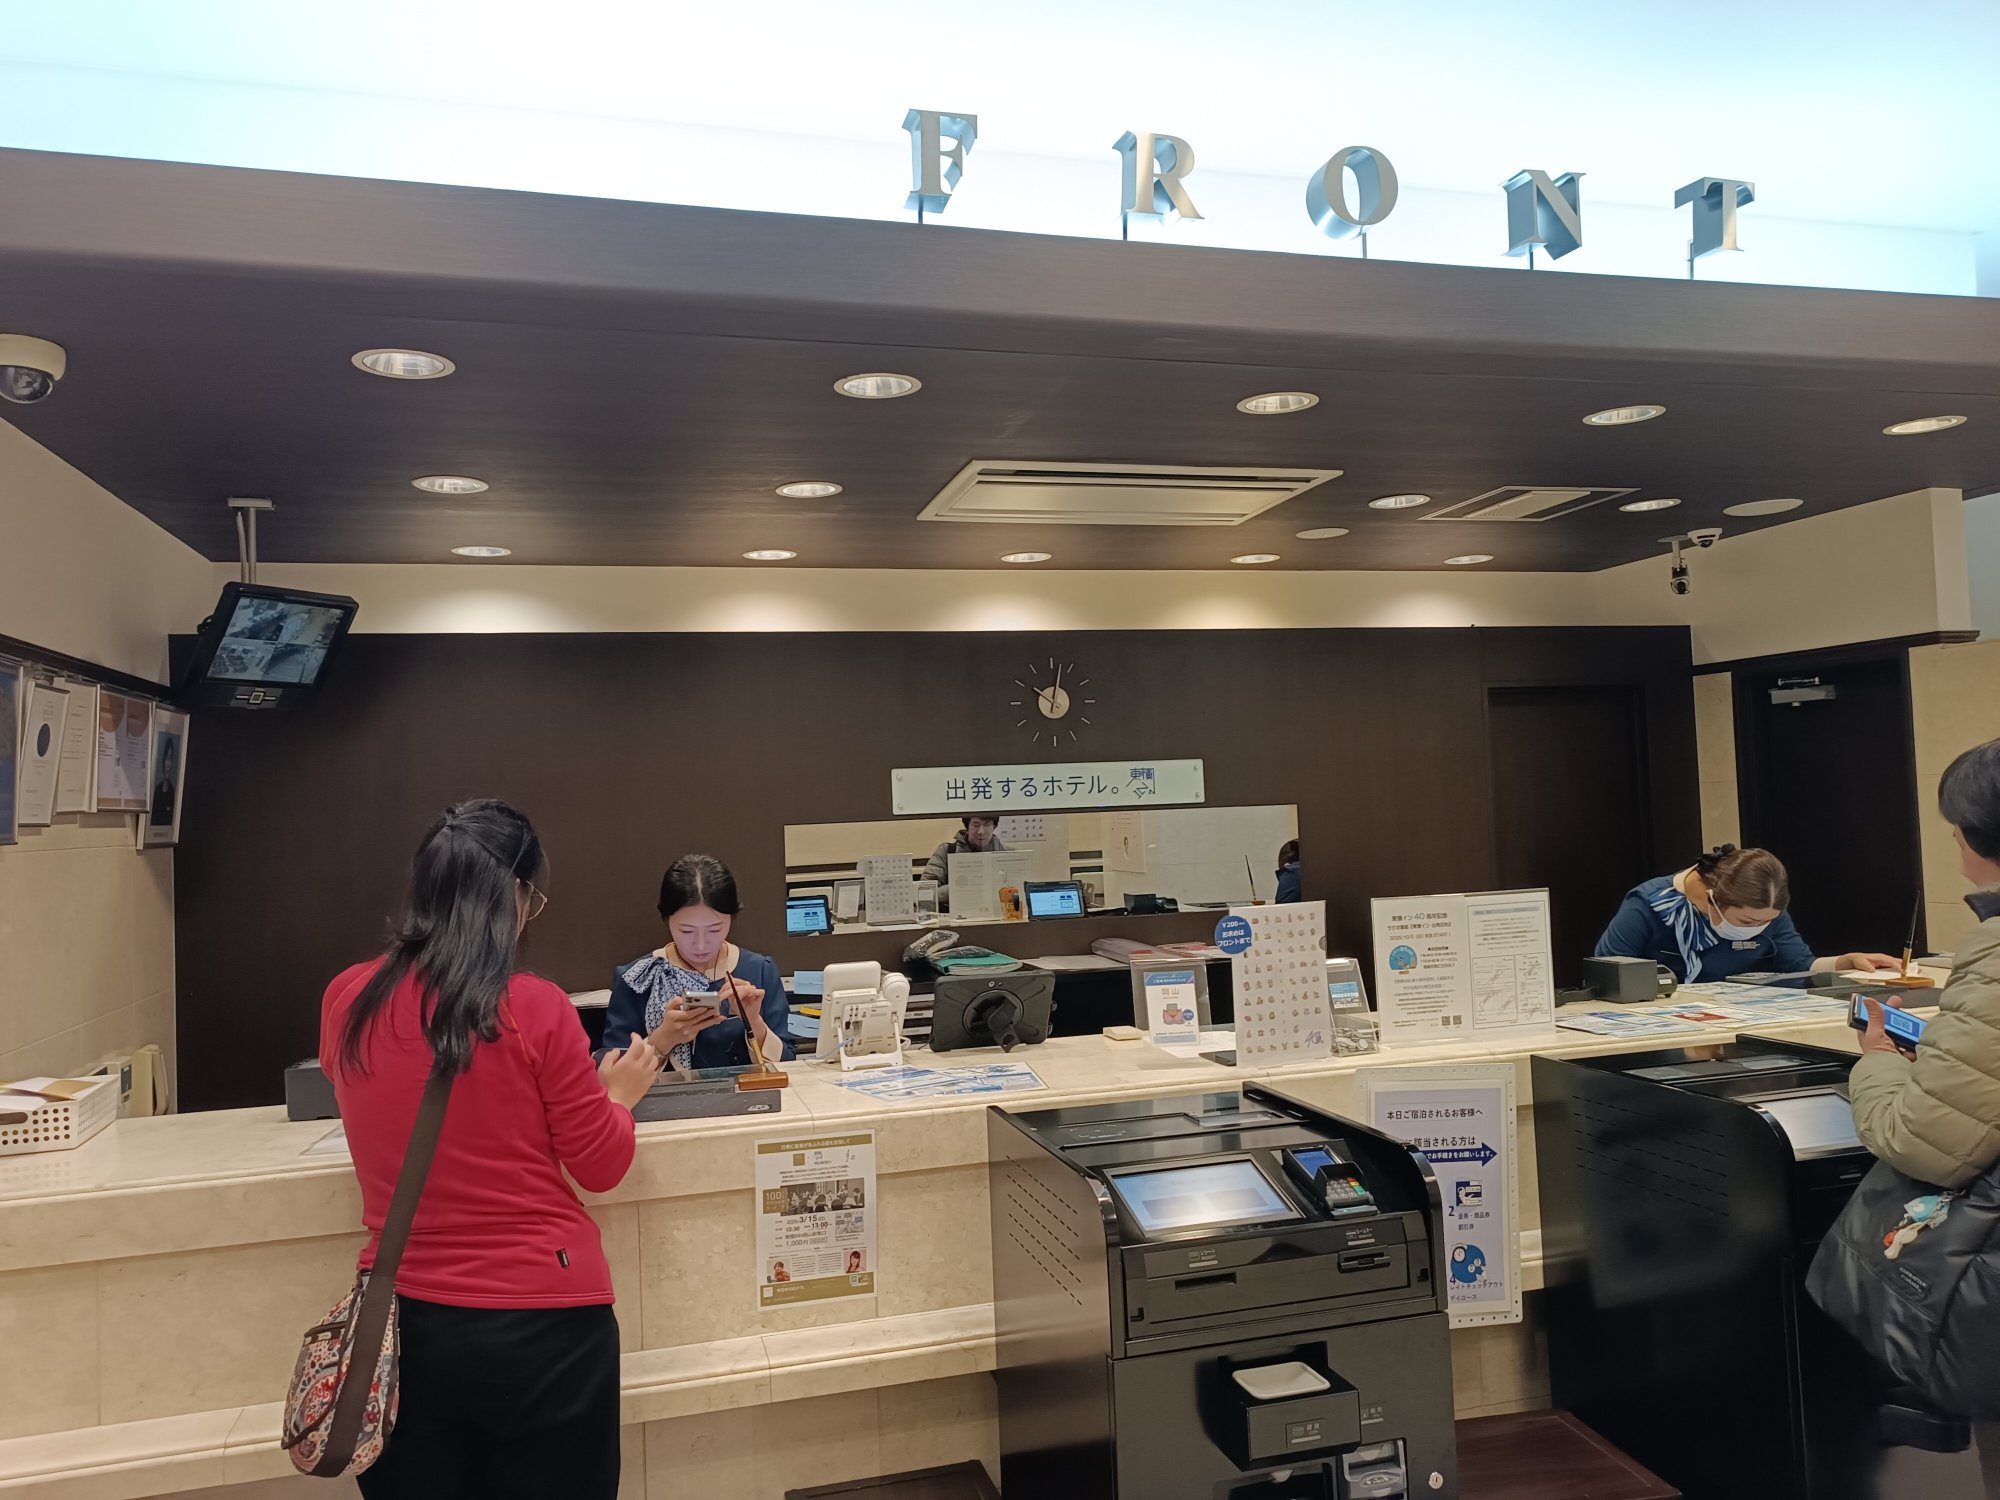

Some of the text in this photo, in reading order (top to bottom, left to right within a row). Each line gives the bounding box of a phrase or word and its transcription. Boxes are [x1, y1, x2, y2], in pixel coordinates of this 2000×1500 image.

[902, 107, 1756, 262] FRONT
[945, 774, 1120, 801] 出発するホテル。
[1222, 929, 1245, 938] お求めは
[1217, 937, 1251, 947] フロントまで
[1387, 1108, 1484, 1120] 本日ご宿泊されるお客様へ
[1448, 1206, 1455, 1217] 2
[799, 1215, 818, 1224] 3/15
